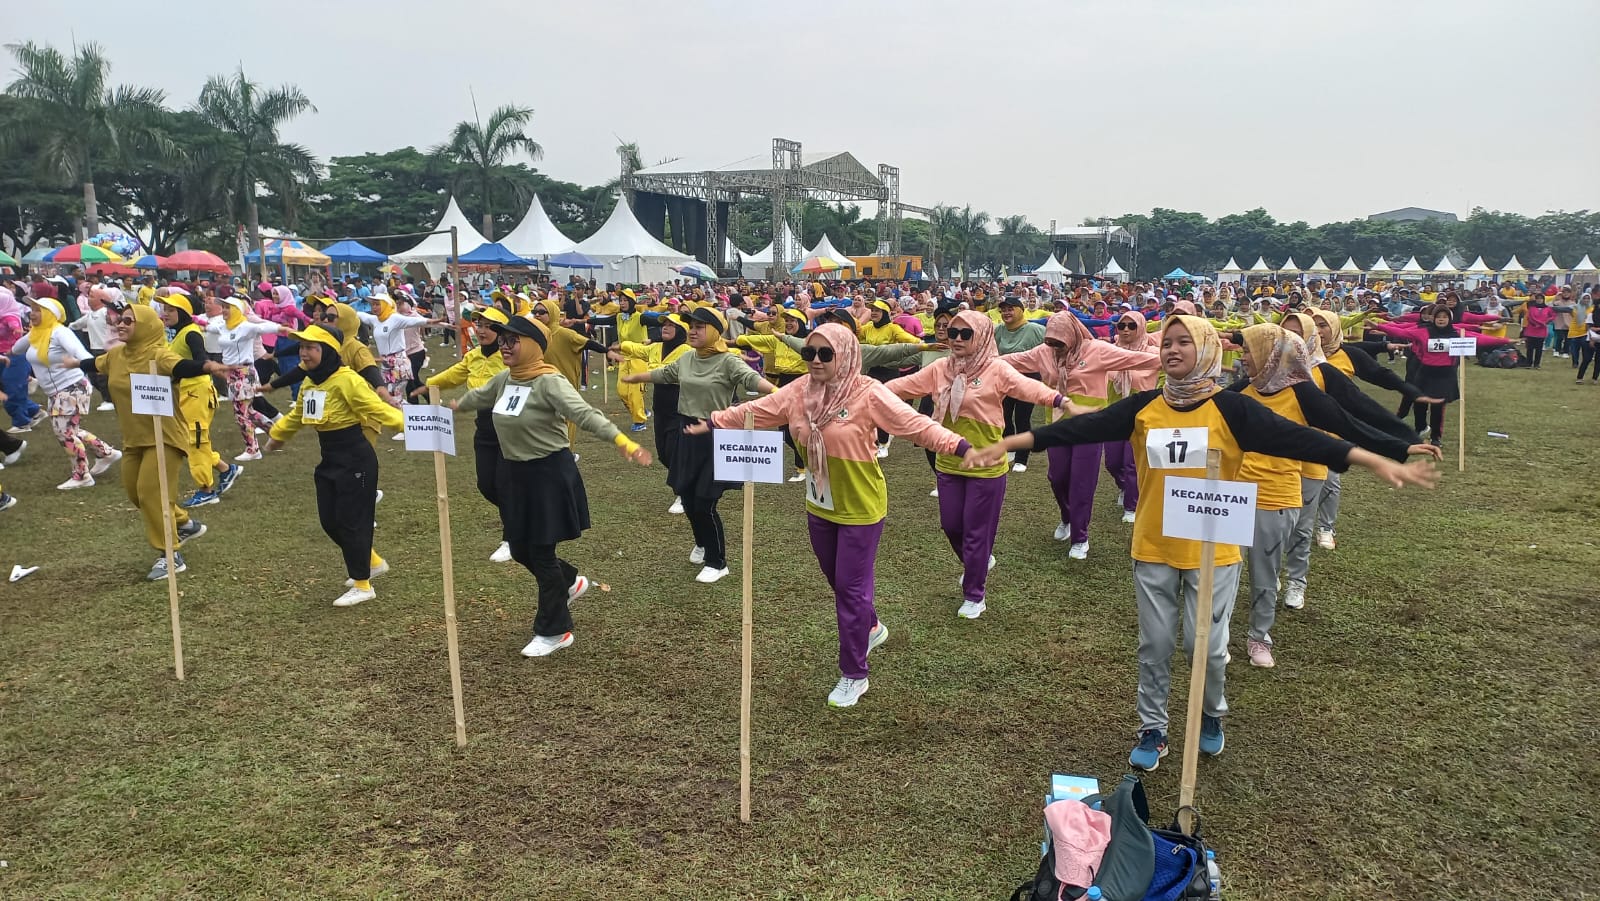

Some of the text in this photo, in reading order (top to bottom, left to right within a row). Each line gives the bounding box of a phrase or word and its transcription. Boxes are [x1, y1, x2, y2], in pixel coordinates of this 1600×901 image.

[306, 399, 316, 415] 10
[408, 415, 450, 425] KECAMATAN
[719, 444, 777, 453] KECAMATAN
[1165, 441, 1188, 463] 17
[726, 456, 771, 465] BANDUNG
[1171, 489, 1248, 504] KECAMATAN
[1187, 504, 1229, 517] BAROS
